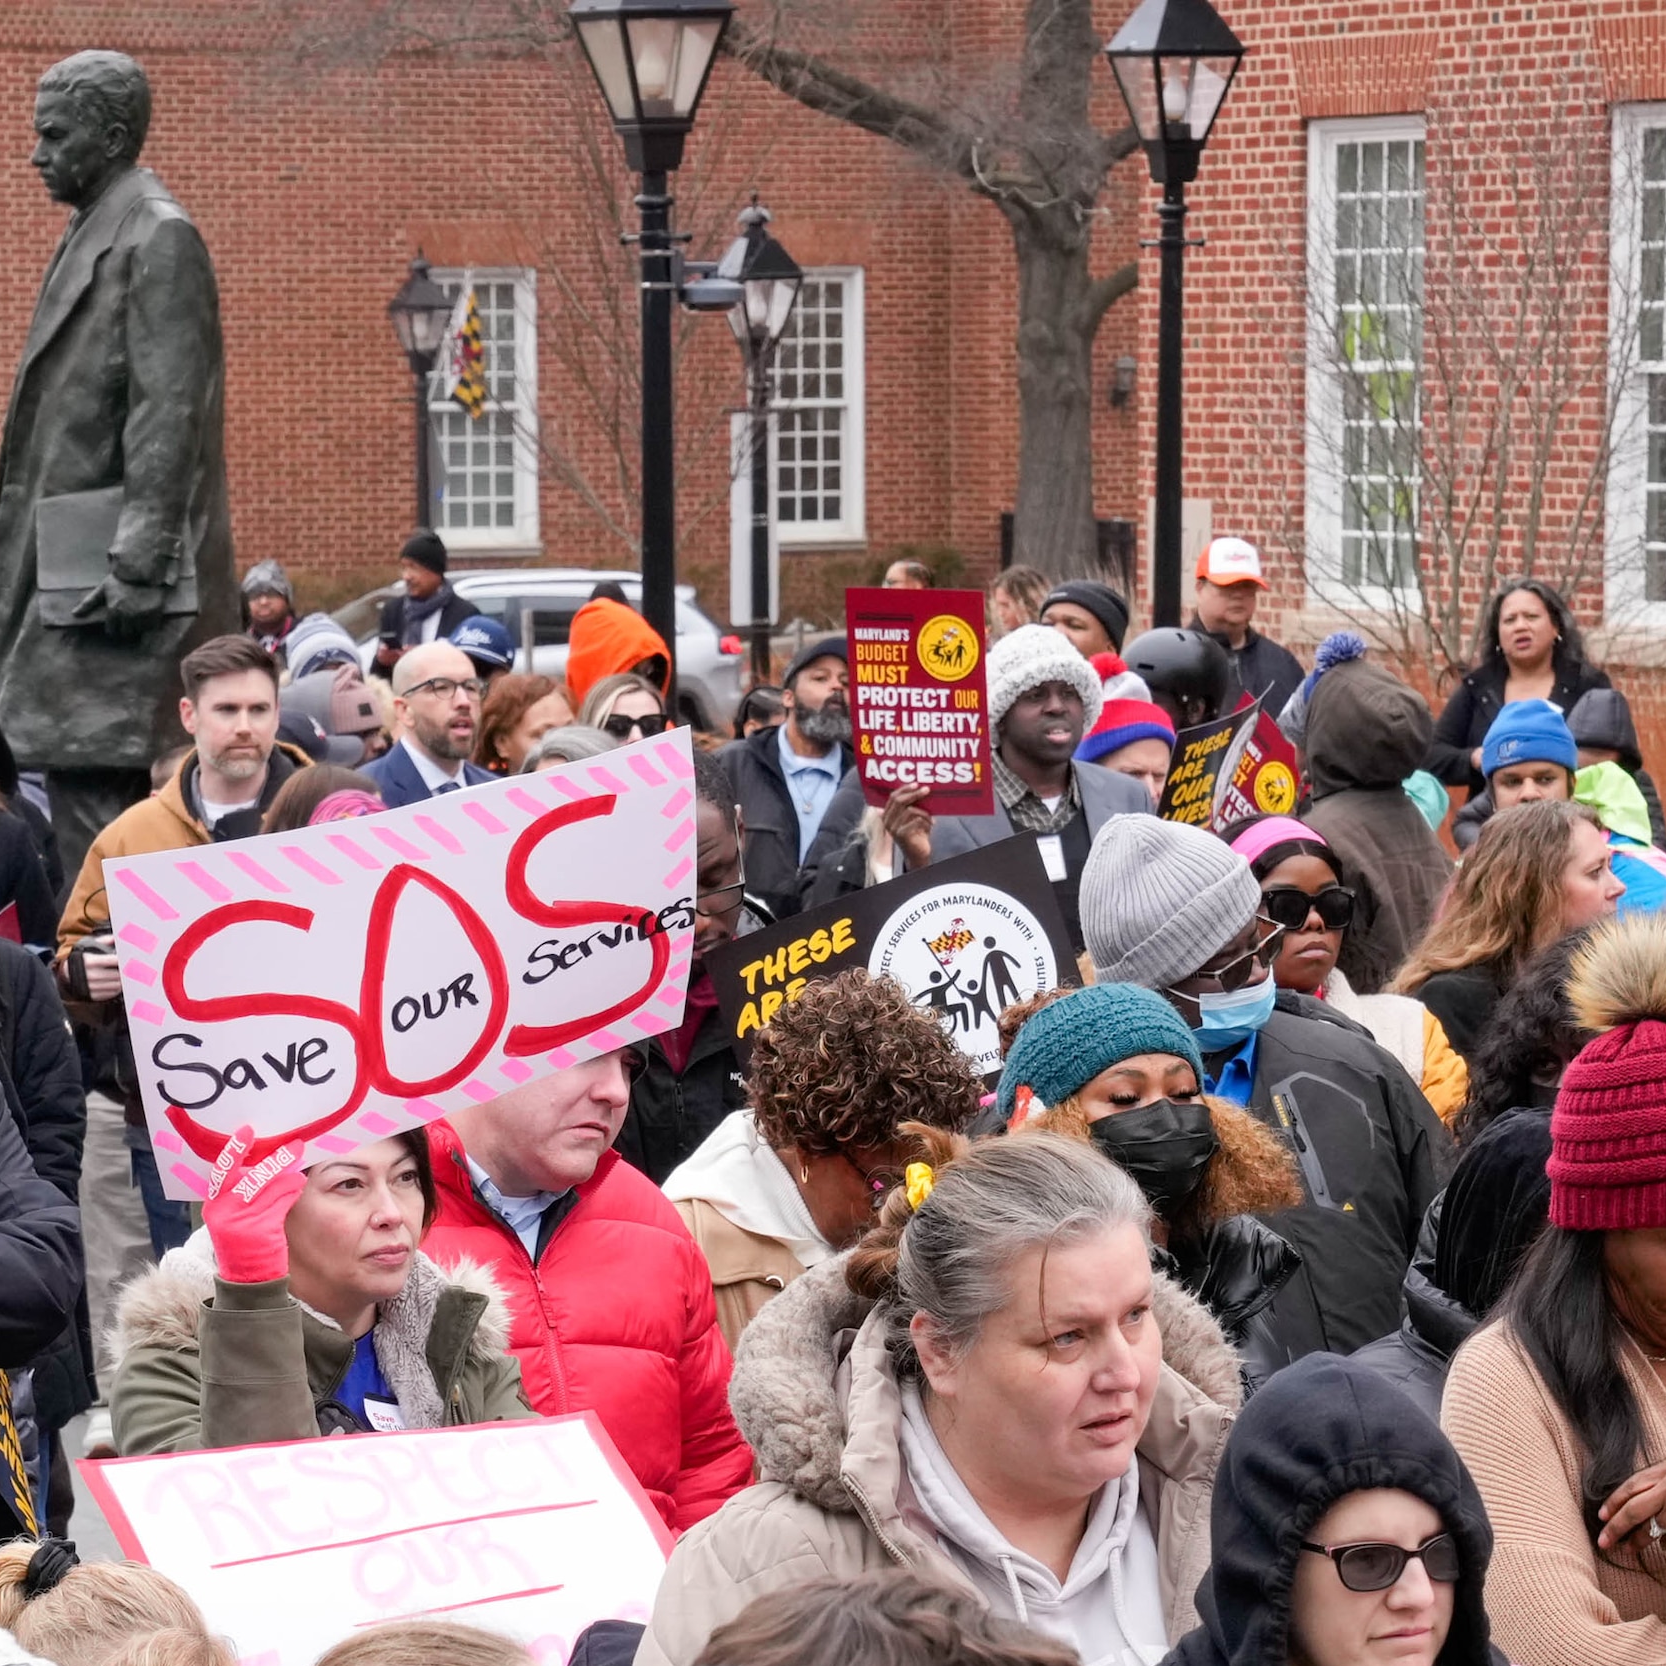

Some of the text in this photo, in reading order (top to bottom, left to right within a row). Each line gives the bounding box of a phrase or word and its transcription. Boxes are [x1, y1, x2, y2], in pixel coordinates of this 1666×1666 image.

[854, 627, 910, 642] MARYLAND'S
[856, 644, 909, 663] BUDGET
[857, 665, 910, 684] MUST
[857, 686, 979, 709] PROTECT OUR
[859, 710, 982, 735] LIFE, LIBERTY,
[860, 735, 981, 758] & COMMUNITY
[1184, 727, 1232, 762] THESE
[865, 759, 981, 783] ACCESS!
[1168, 757, 1206, 786] ARE
[1171, 773, 1215, 806] OUR
[880, 895, 1034, 975] TECT SERVICES FOR MARYLANDERS WITH
[739, 917, 856, 995] THESE
[152, 897, 694, 1110] Save OUR Services
[232, 1146, 296, 1203] PINK
[145, 1430, 575, 1557] RESPECT
[353, 1522, 542, 1606] OUR
